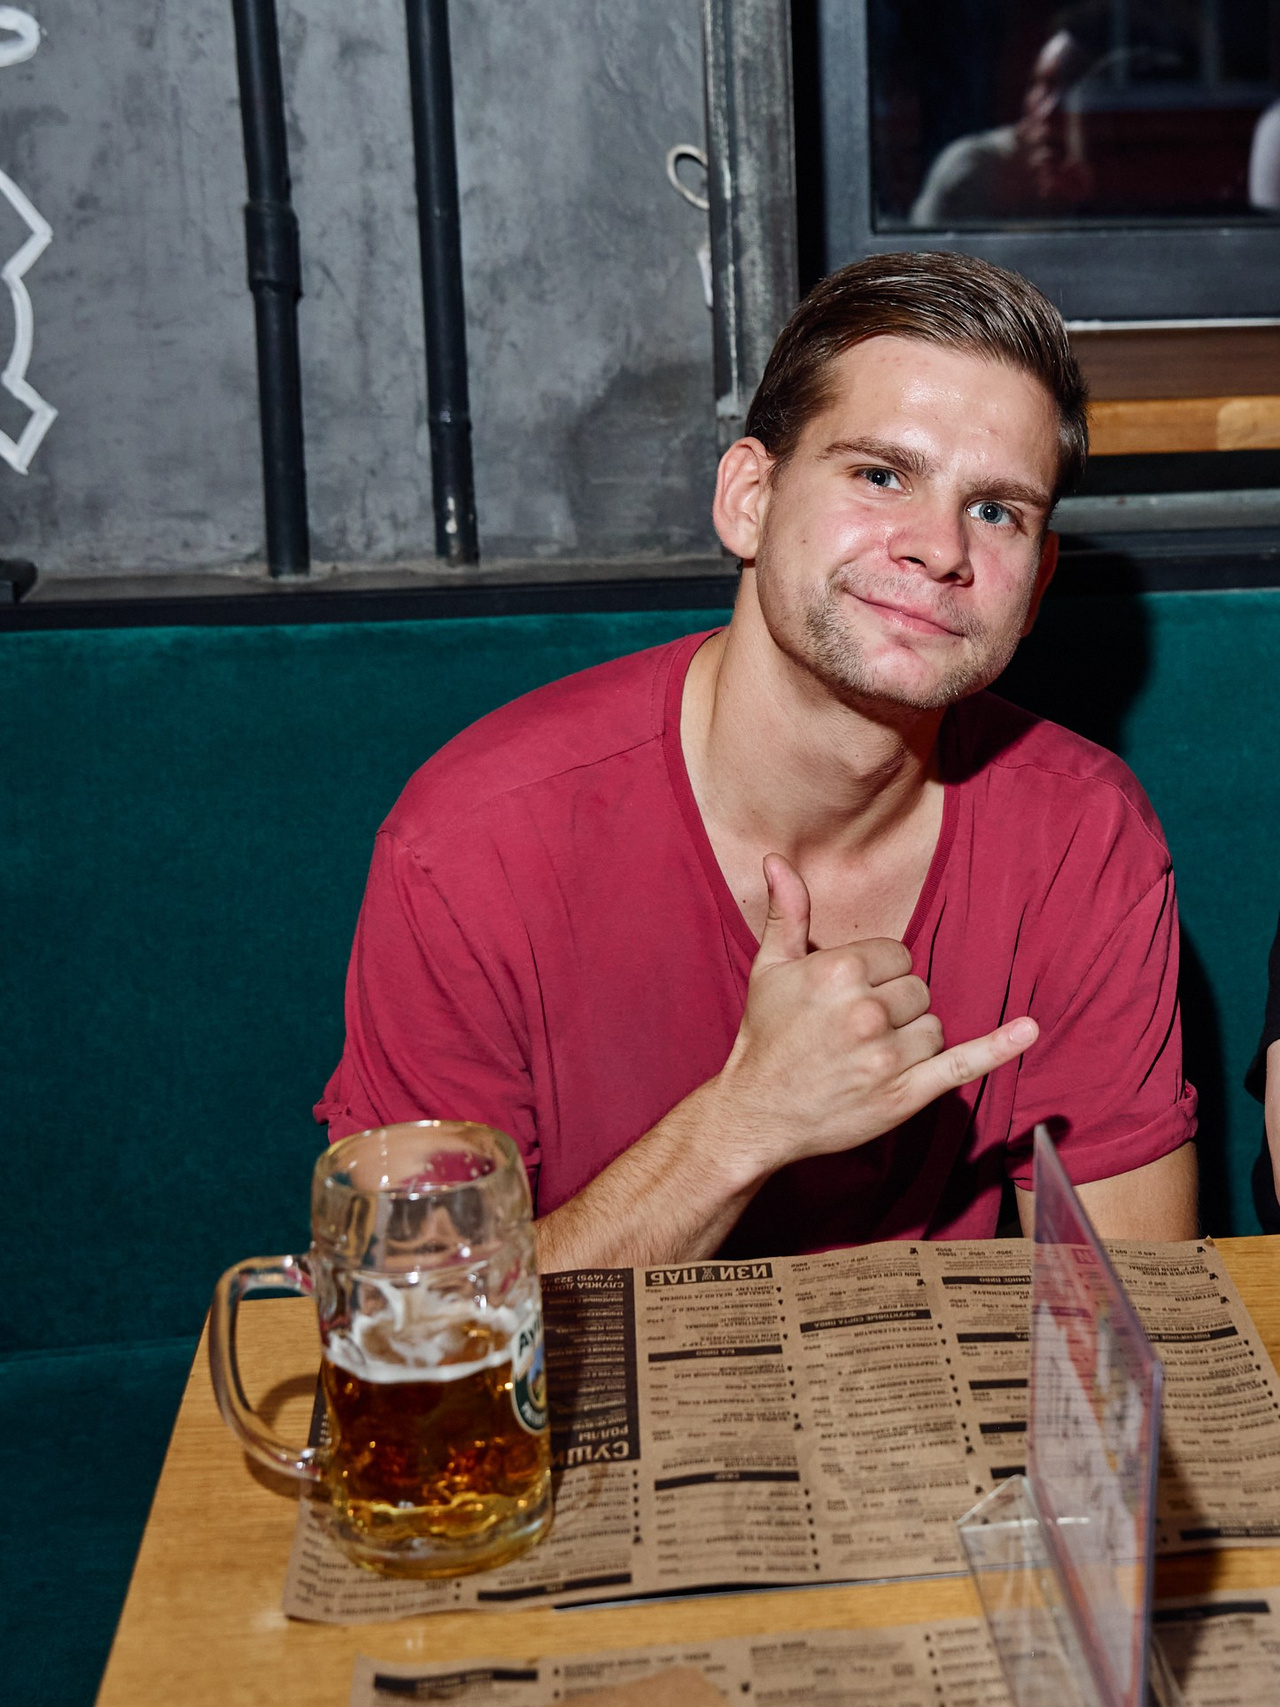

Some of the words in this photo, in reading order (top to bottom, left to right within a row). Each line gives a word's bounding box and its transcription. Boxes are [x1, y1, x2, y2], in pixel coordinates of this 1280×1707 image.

[720, 1264, 768, 1280] ИЗИ
[554, 1276, 574, 1284] 323
[576, 1274, 604, 1282] (495)
[650, 1268, 697, 1285] ПАБ
[856, 1273, 882, 1281] CASSIS
[979, 1276, 1001, 1284] ПИВО
[838, 1316, 864, 1324] СОРТА
[865, 1312, 916, 1322] ФРУКТОВЫЕ
[814, 1320, 836, 1328] ПИВА
[578, 1424, 628, 1442] РОЛЛЫ
